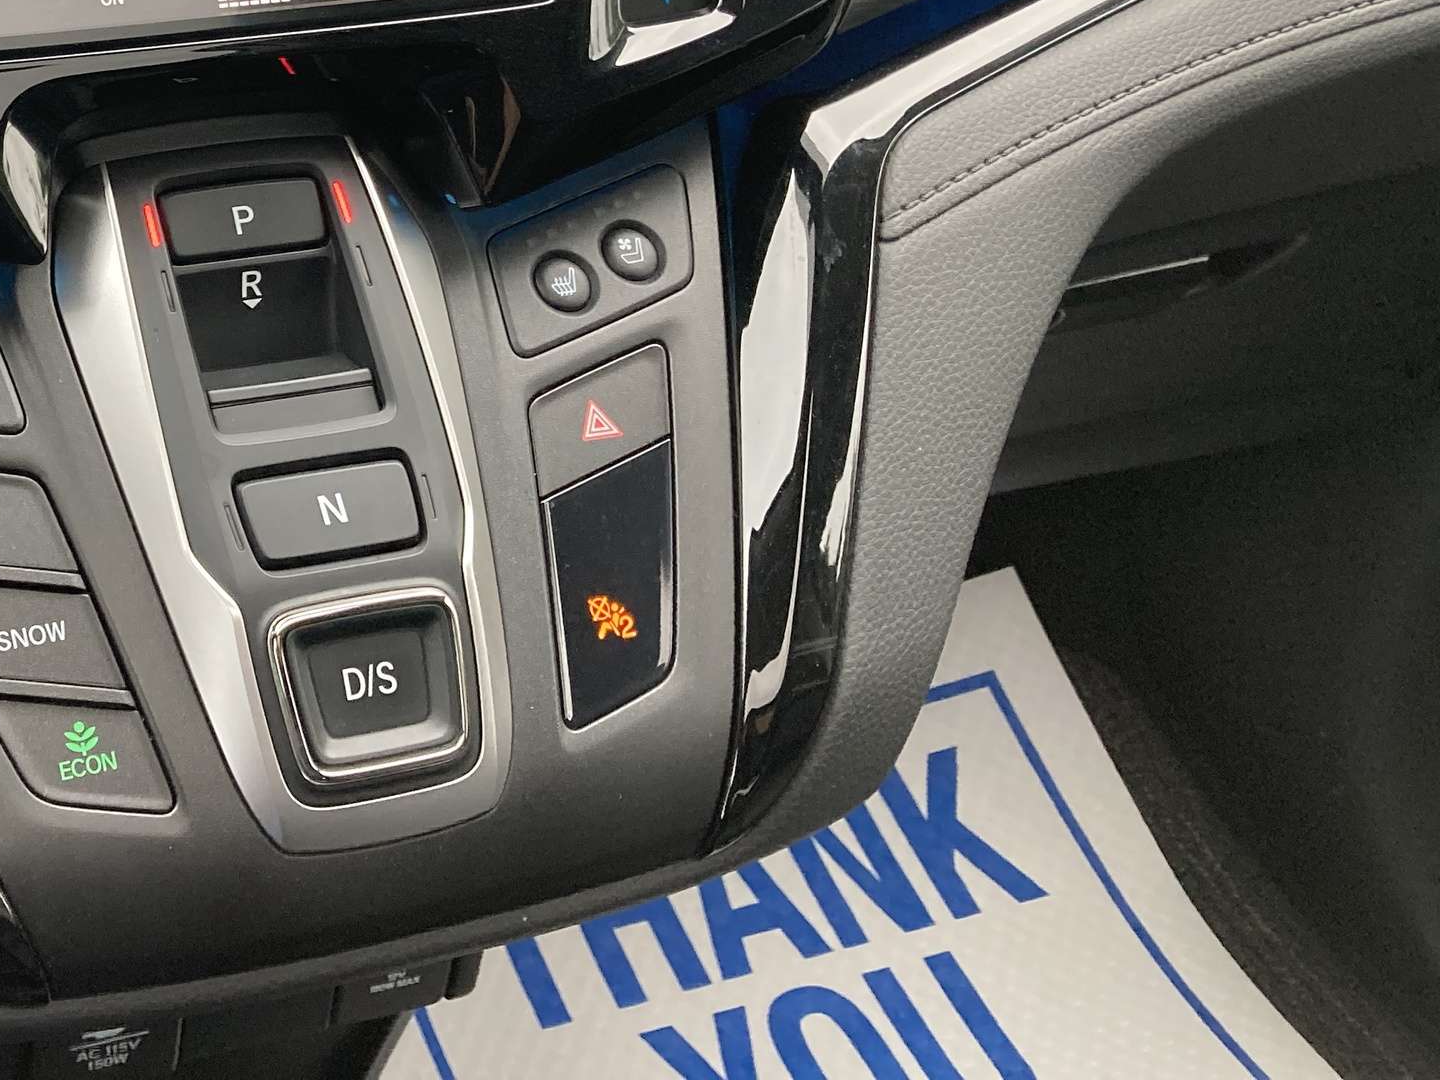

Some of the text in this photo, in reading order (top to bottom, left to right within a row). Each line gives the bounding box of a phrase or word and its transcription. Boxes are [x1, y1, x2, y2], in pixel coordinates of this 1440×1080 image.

[233, 205, 255, 236] P
[241, 271, 261, 298] R
[317, 493, 350, 526] N
[341, 661, 399, 702] D/S
[58, 750, 119, 781] ECON
